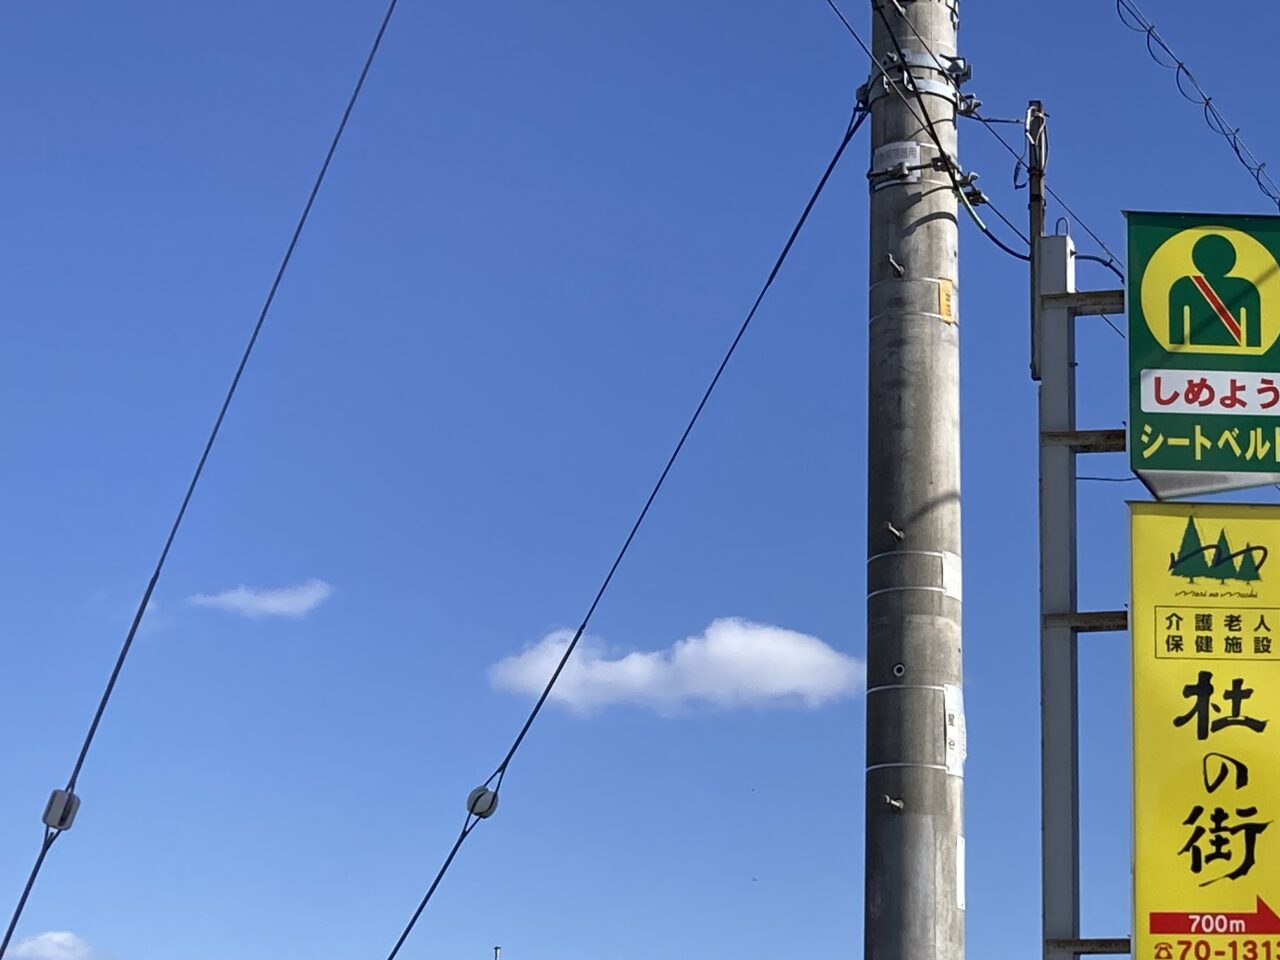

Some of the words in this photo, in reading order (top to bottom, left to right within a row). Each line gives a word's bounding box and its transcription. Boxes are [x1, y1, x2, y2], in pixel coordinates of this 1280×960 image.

[1154, 376, 1280, 409] しめよう
[1165, 612, 1272, 632] 介護老人
[1165, 634, 1272, 654] 保健施設
[1173, 671, 1273, 887] 杜の街
[1188, 915, 1246, 933] 700m
